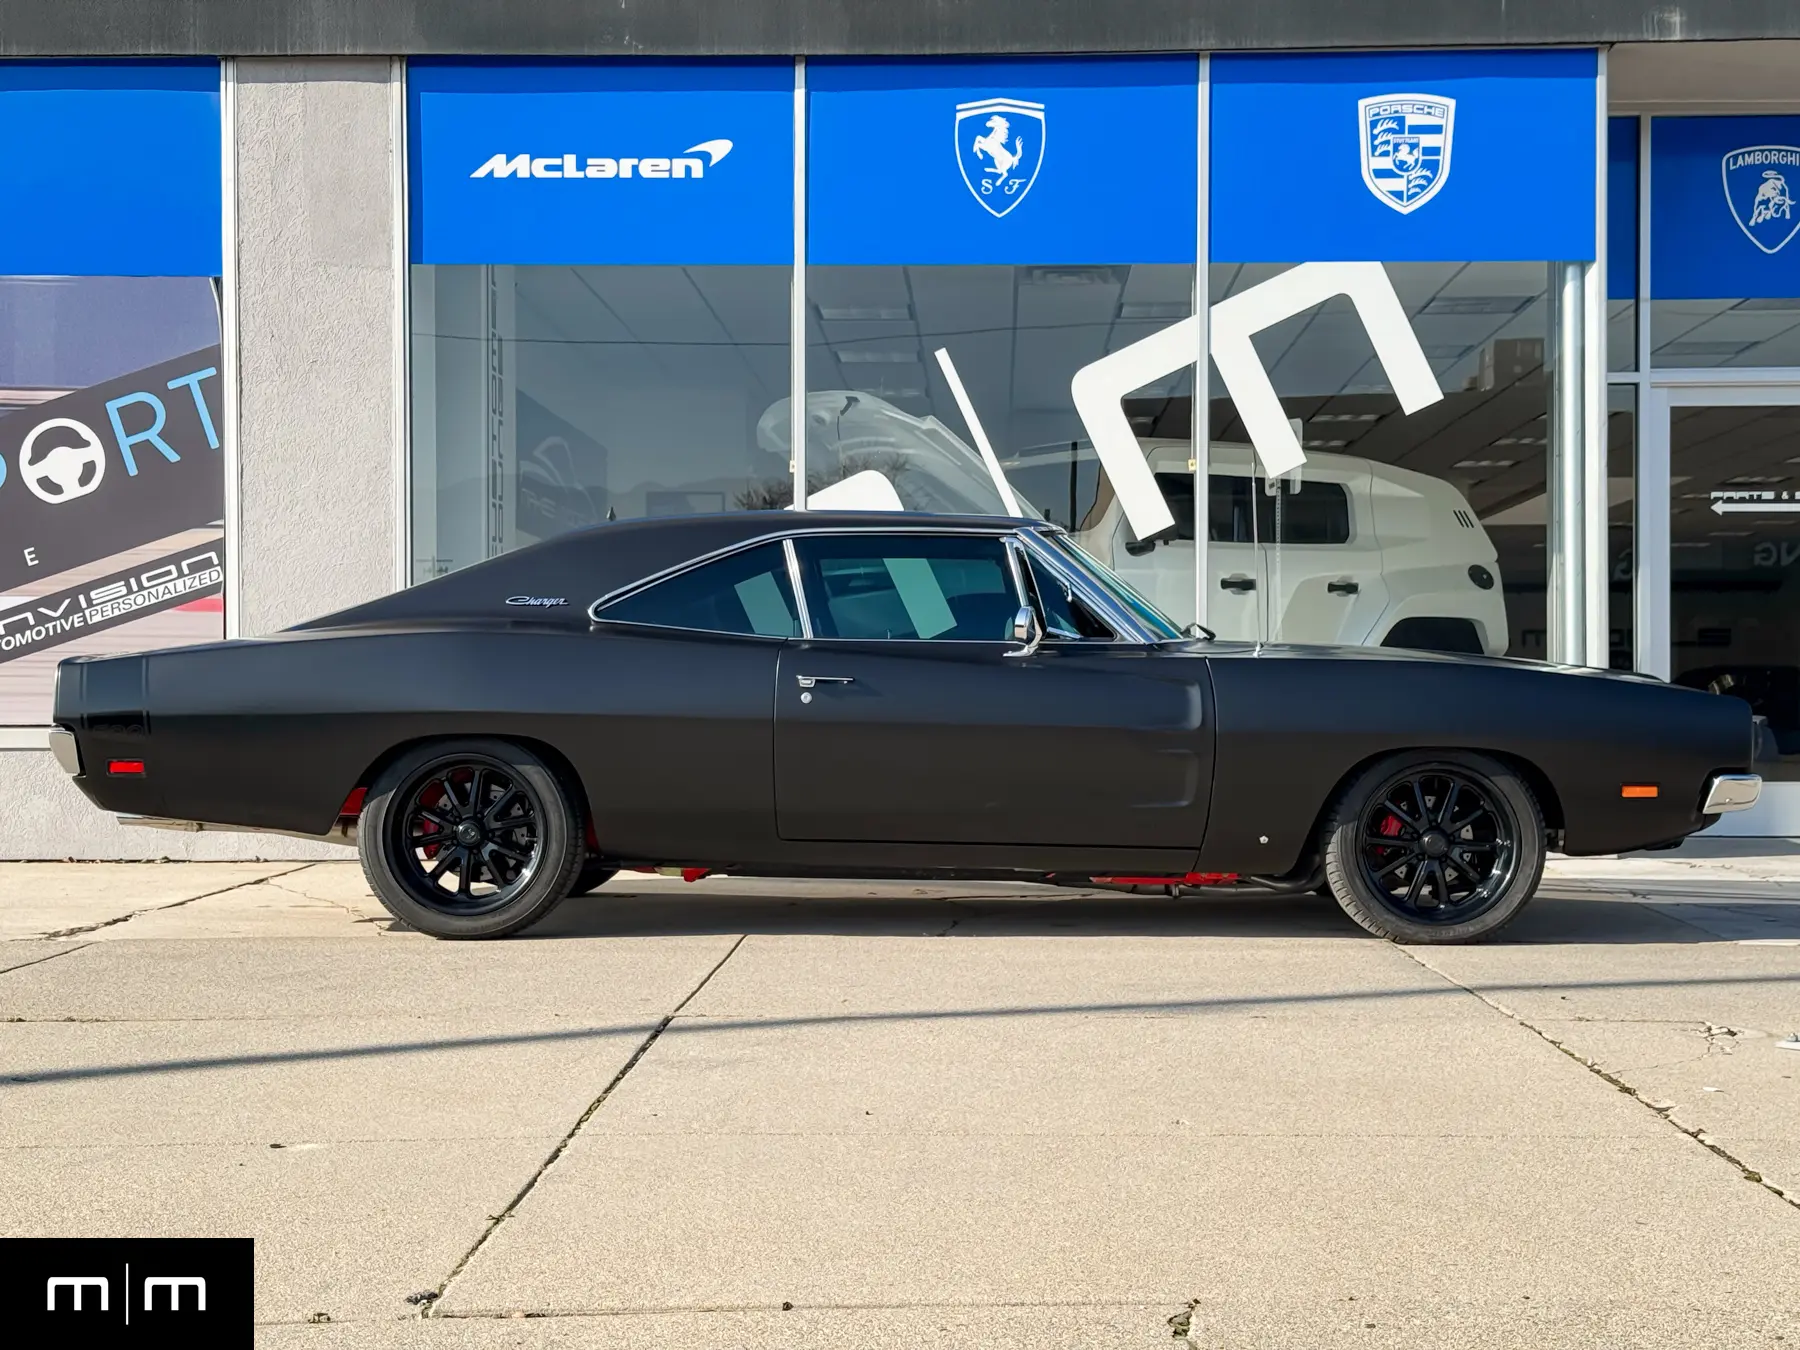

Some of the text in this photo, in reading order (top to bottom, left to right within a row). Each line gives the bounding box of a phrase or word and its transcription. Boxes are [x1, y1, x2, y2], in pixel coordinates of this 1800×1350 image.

[1369, 103, 1444, 118] PORSCHE
[469, 152, 705, 179] McLaren
[1729, 150, 1800, 171] LAMBORGHI
[1781, 490, 1789, 500] &
[24, 547, 39, 567] E
[86, 567, 222, 624] PERSONALIZED
[505, 595, 569, 609] Charger
